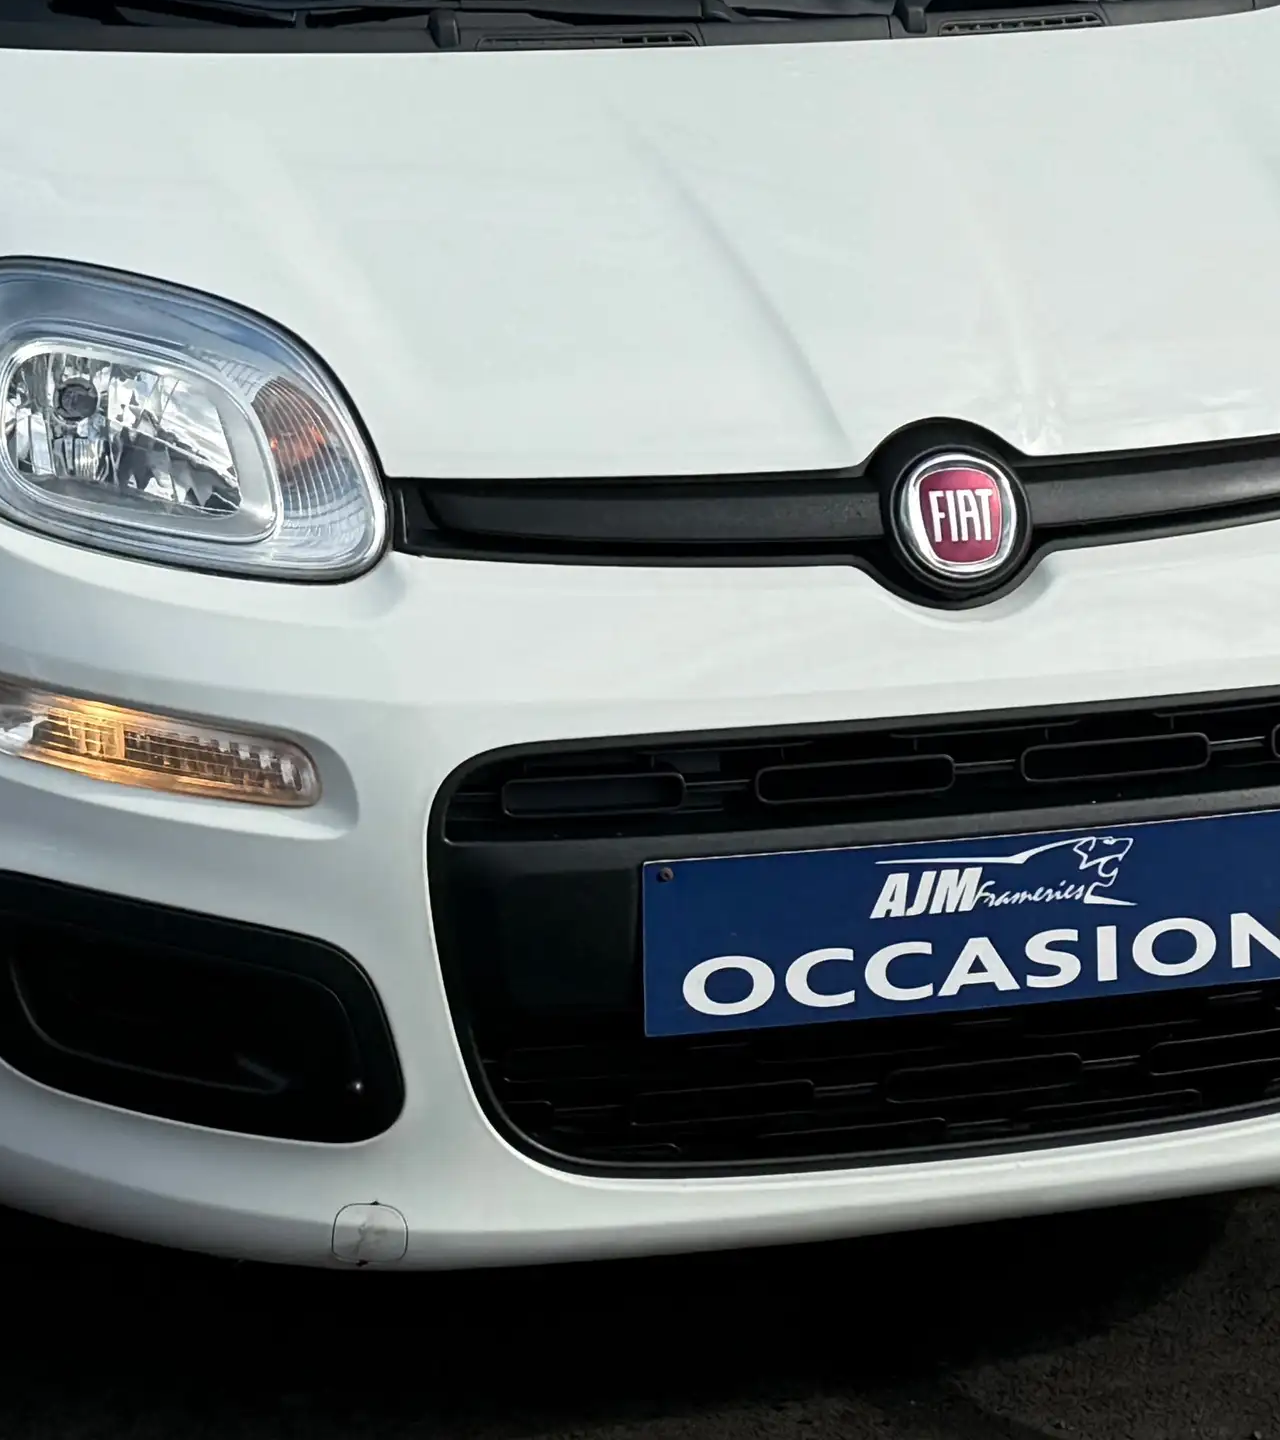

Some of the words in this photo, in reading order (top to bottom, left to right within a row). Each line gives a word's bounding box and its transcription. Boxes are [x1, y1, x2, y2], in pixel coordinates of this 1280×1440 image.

[928, 488, 993, 542] FIAT
[870, 867, 983, 919] AJM
[974, 880, 1085, 907] Frameries
